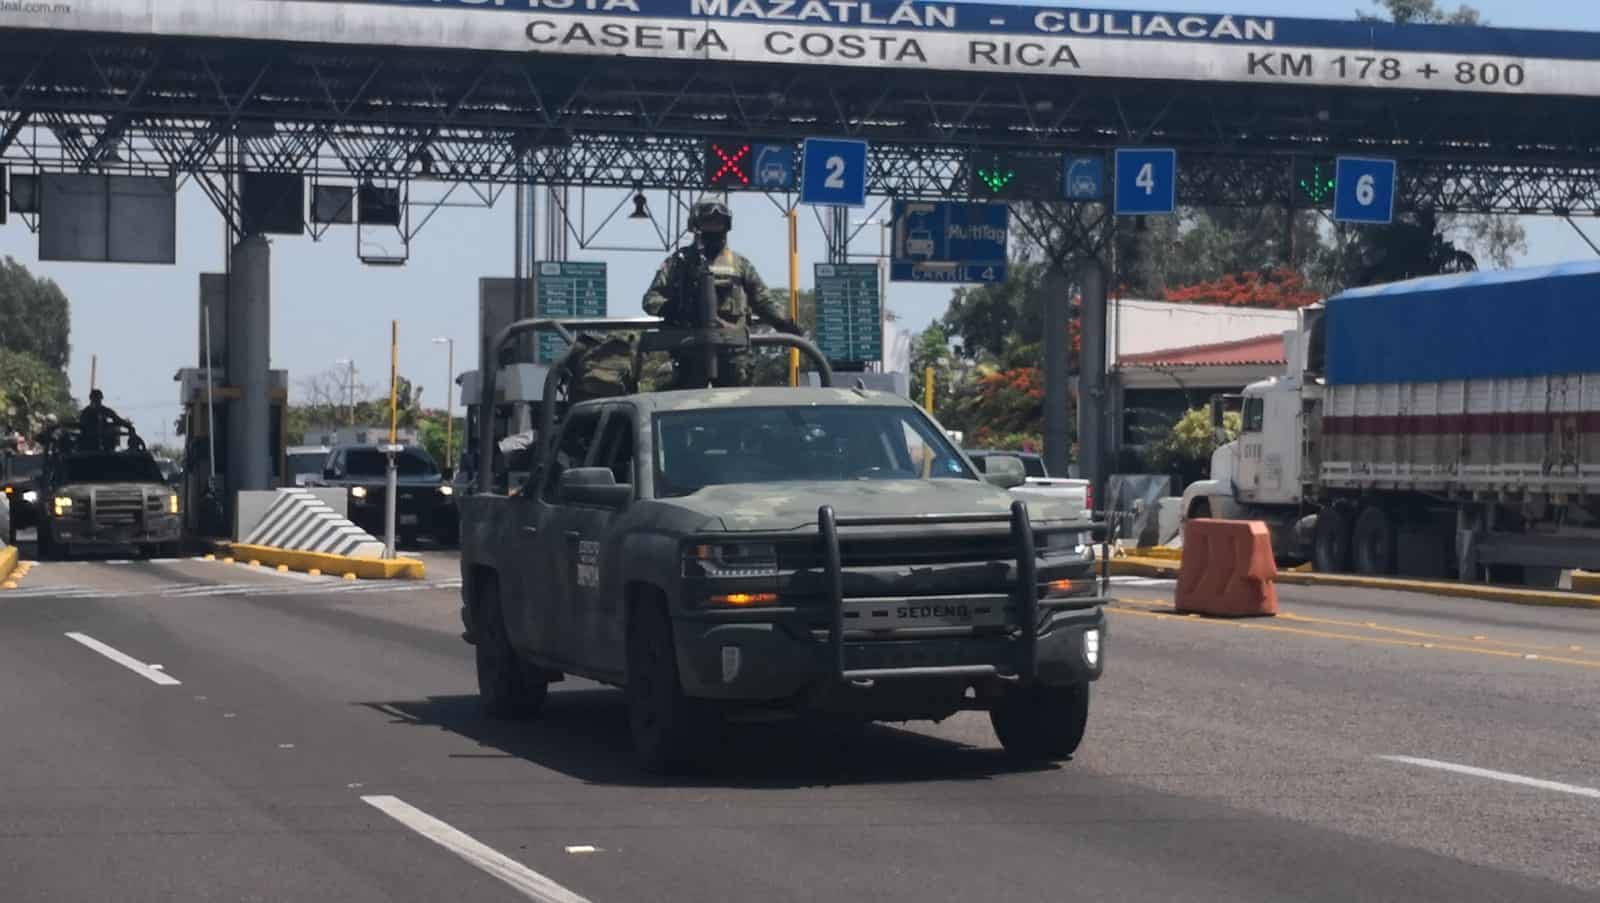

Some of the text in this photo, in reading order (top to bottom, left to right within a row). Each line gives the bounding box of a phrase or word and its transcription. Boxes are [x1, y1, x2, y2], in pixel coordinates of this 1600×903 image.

[690, 0, 956, 28] MAZATLÁN
[1034, 10, 1275, 41] CULIACÁN
[525, 20, 1081, 69] CASETA COSTA RICA
[1247, 52, 1313, 78] KM
[1330, 55, 1401, 81] 178
[1455, 62, 1525, 86] 800
[824, 156, 845, 189] 2
[1135, 163, 1154, 195] 4
[1356, 174, 1374, 206] 6
[981, 267, 996, 281] 4
